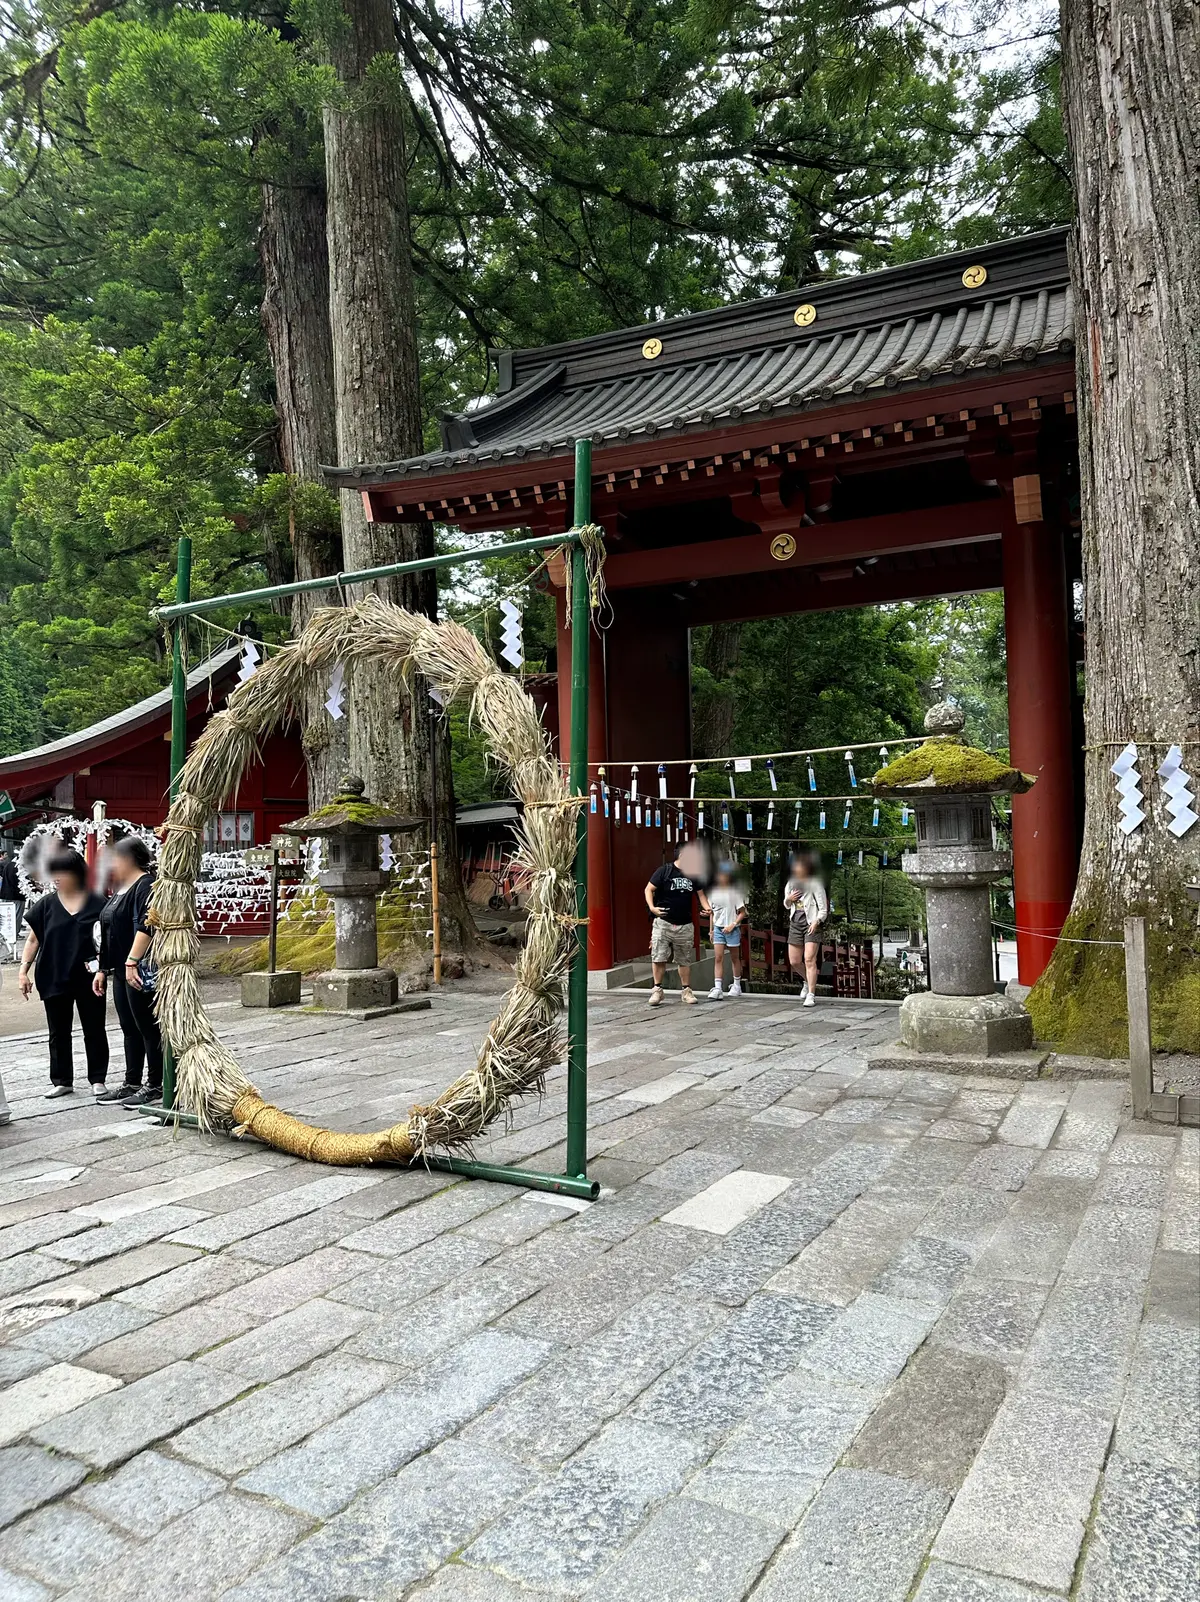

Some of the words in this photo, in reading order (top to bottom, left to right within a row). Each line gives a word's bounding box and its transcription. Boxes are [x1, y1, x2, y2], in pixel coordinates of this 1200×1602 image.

[277, 837, 292, 847] 神苑
[250, 854, 270, 862] 東照宮
